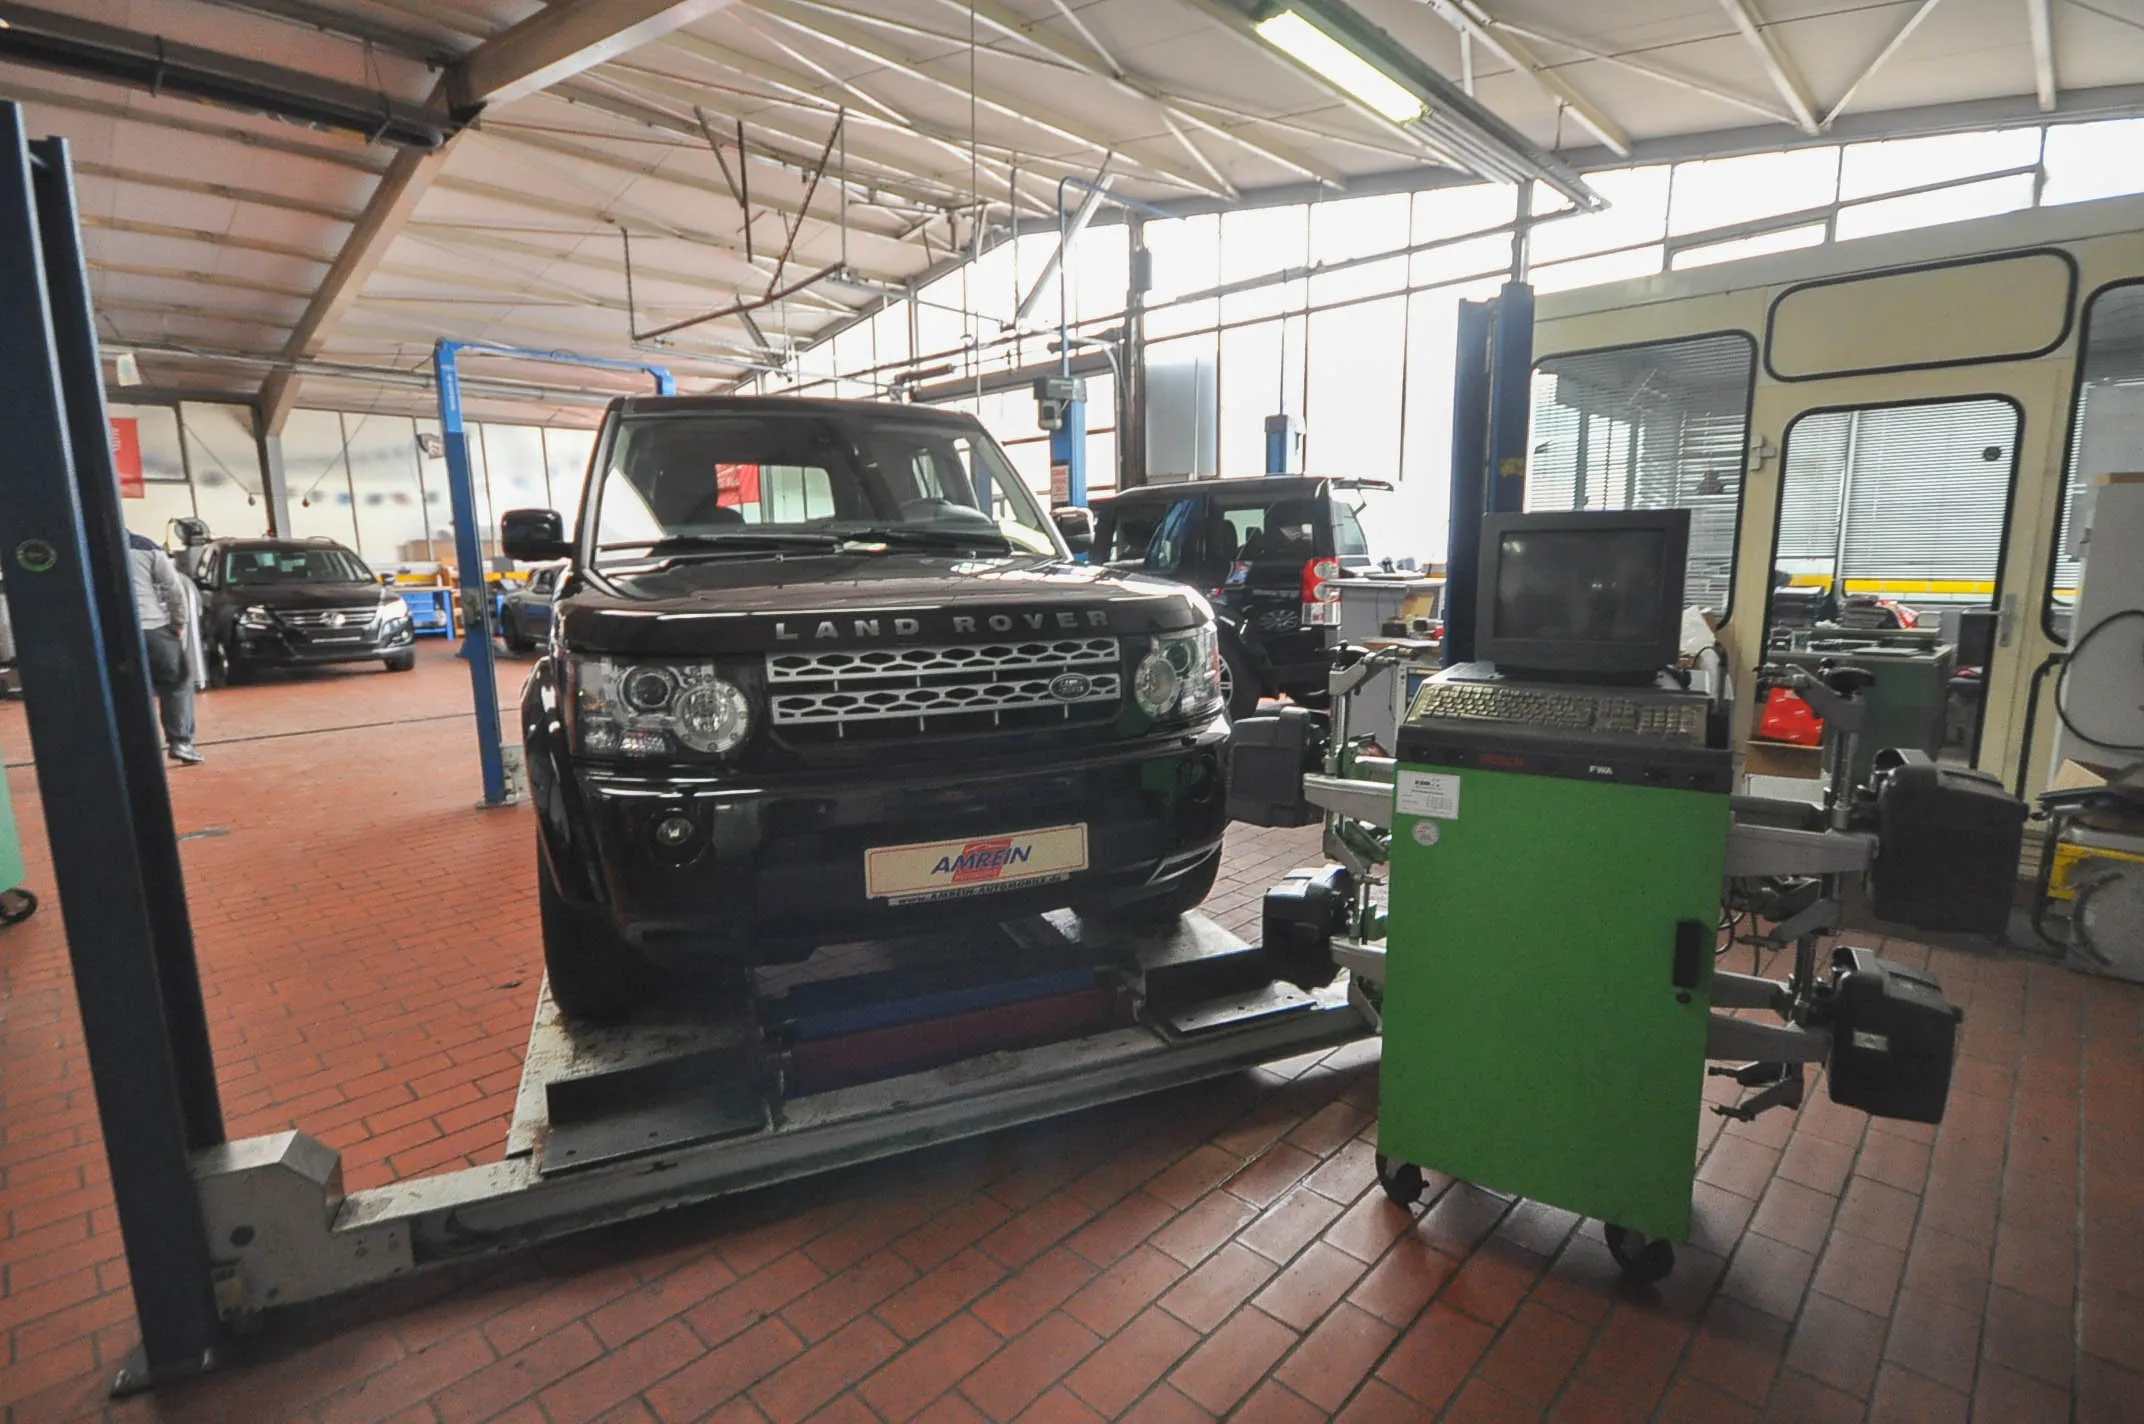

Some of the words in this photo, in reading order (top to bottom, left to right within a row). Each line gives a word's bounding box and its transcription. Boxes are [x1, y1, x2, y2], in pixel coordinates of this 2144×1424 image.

[776, 617, 919, 640] LAND
[953, 610, 1108, 633] ROVER
[931, 845, 1032, 875] AMREIN
